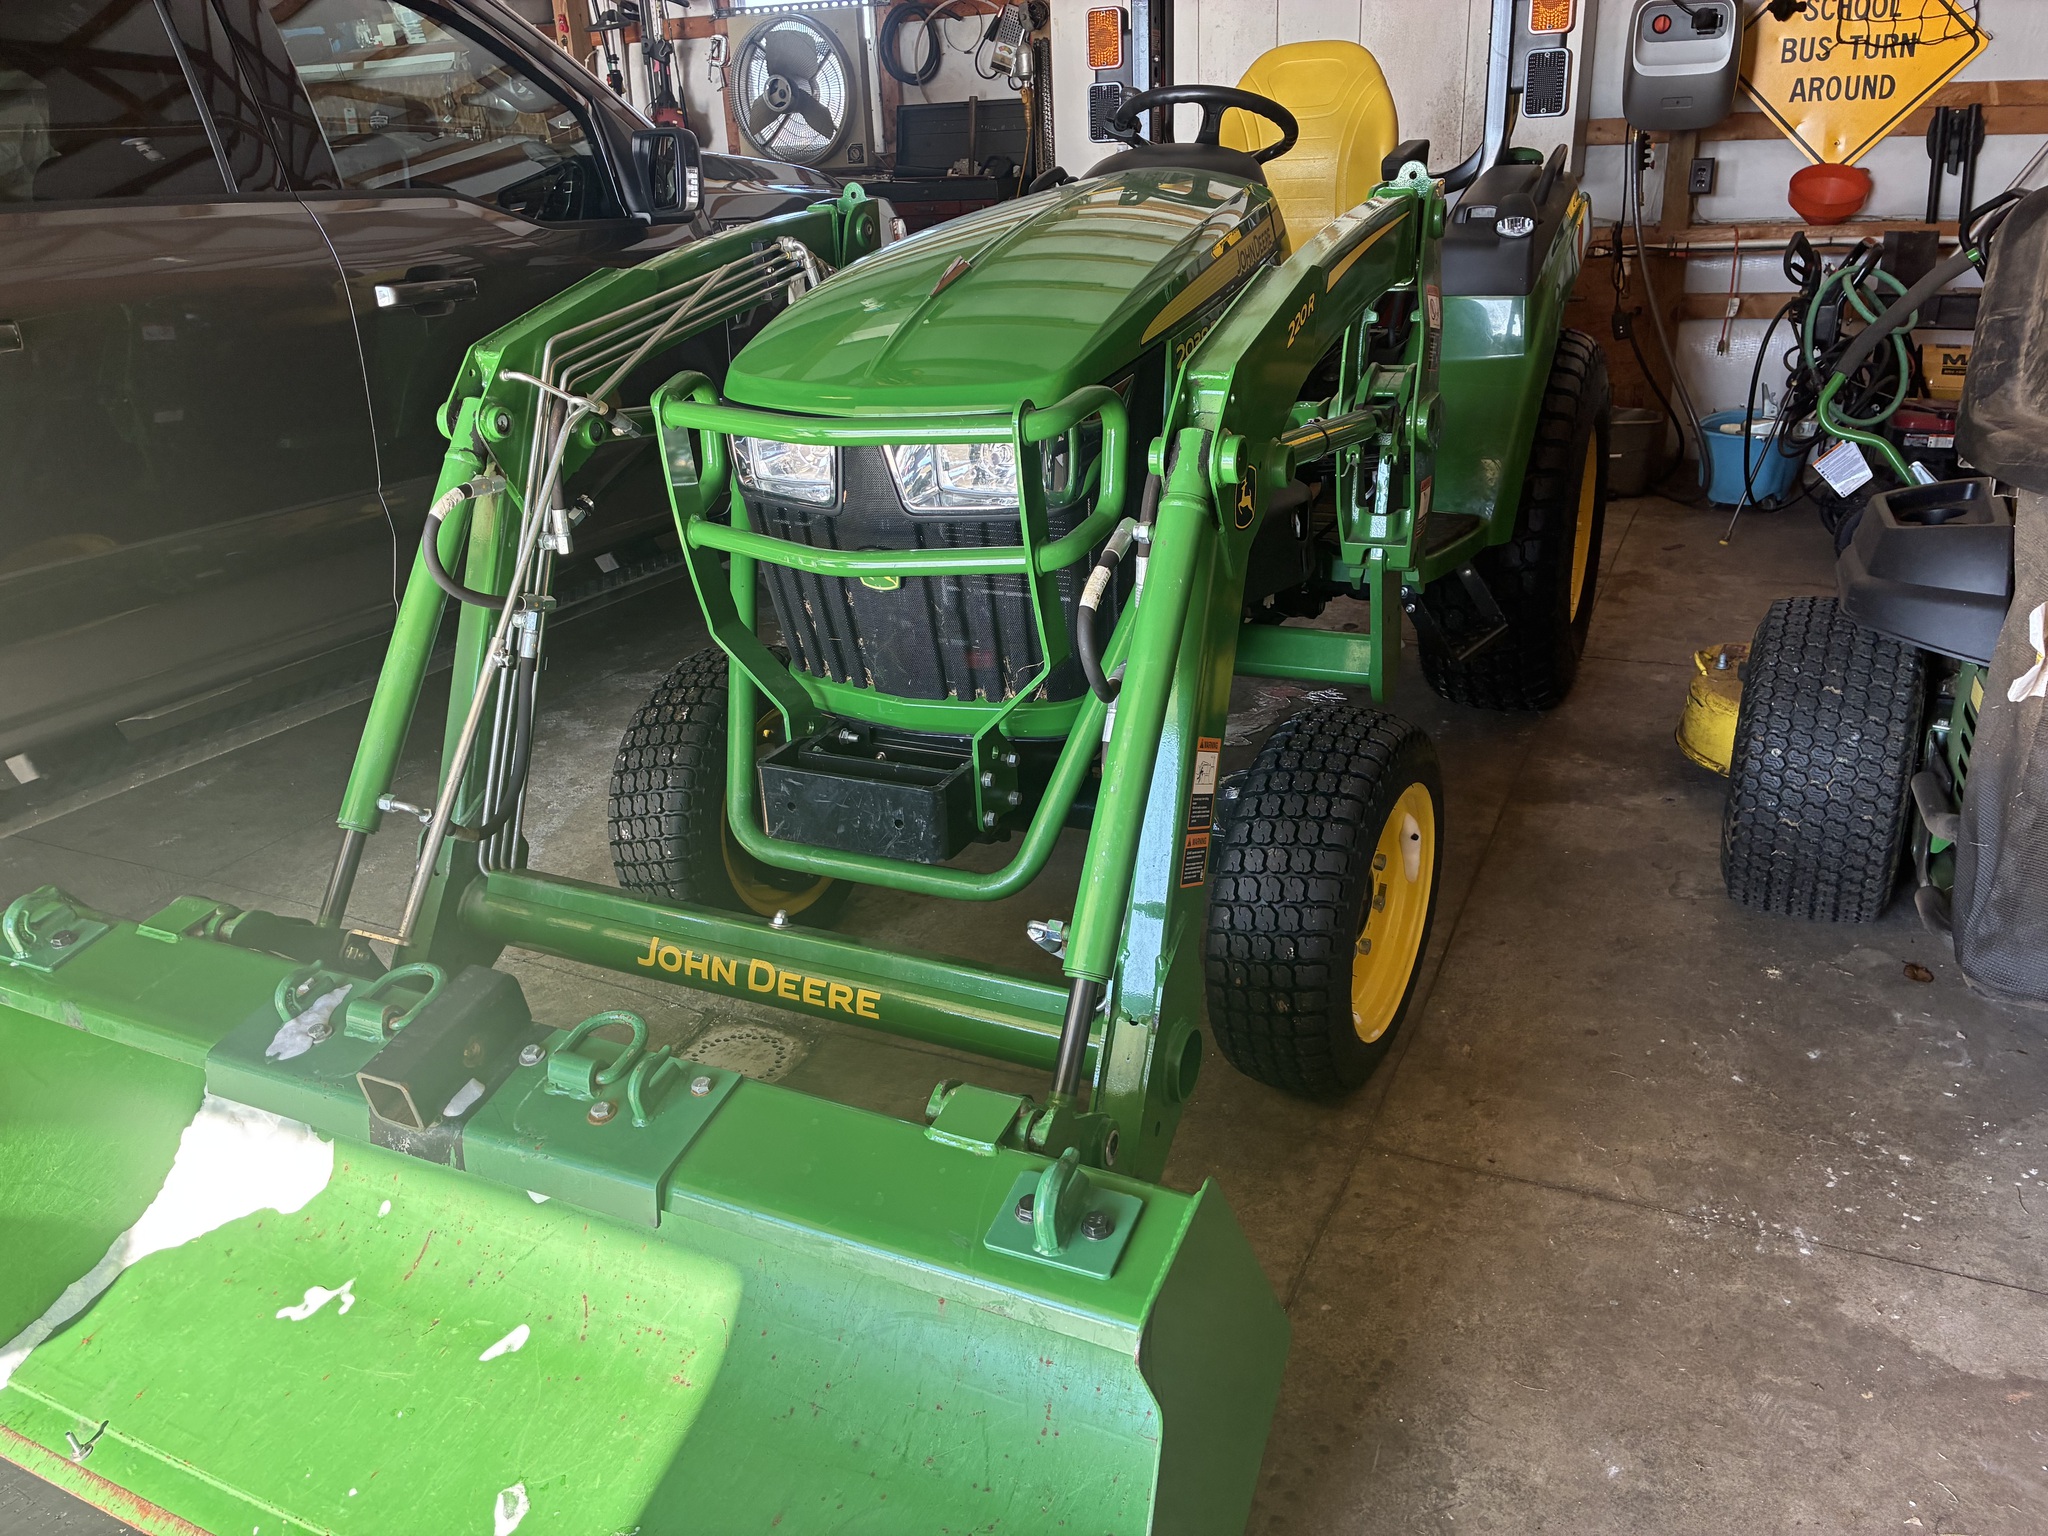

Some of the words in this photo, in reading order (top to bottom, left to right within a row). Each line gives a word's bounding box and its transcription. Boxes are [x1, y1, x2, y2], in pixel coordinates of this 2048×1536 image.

[1803, 0, 1902, 22] SCHOOL
[1780, 36, 1833, 63] BUS
[1850, 32, 1917, 60] TURN
[1788, 74, 1896, 103] AROUND
[1236, 241, 1256, 277] JOHN
[1287, 293, 1315, 349] 220R
[637, 936, 738, 986] JOHN
[748, 958, 882, 1020] DEERE
